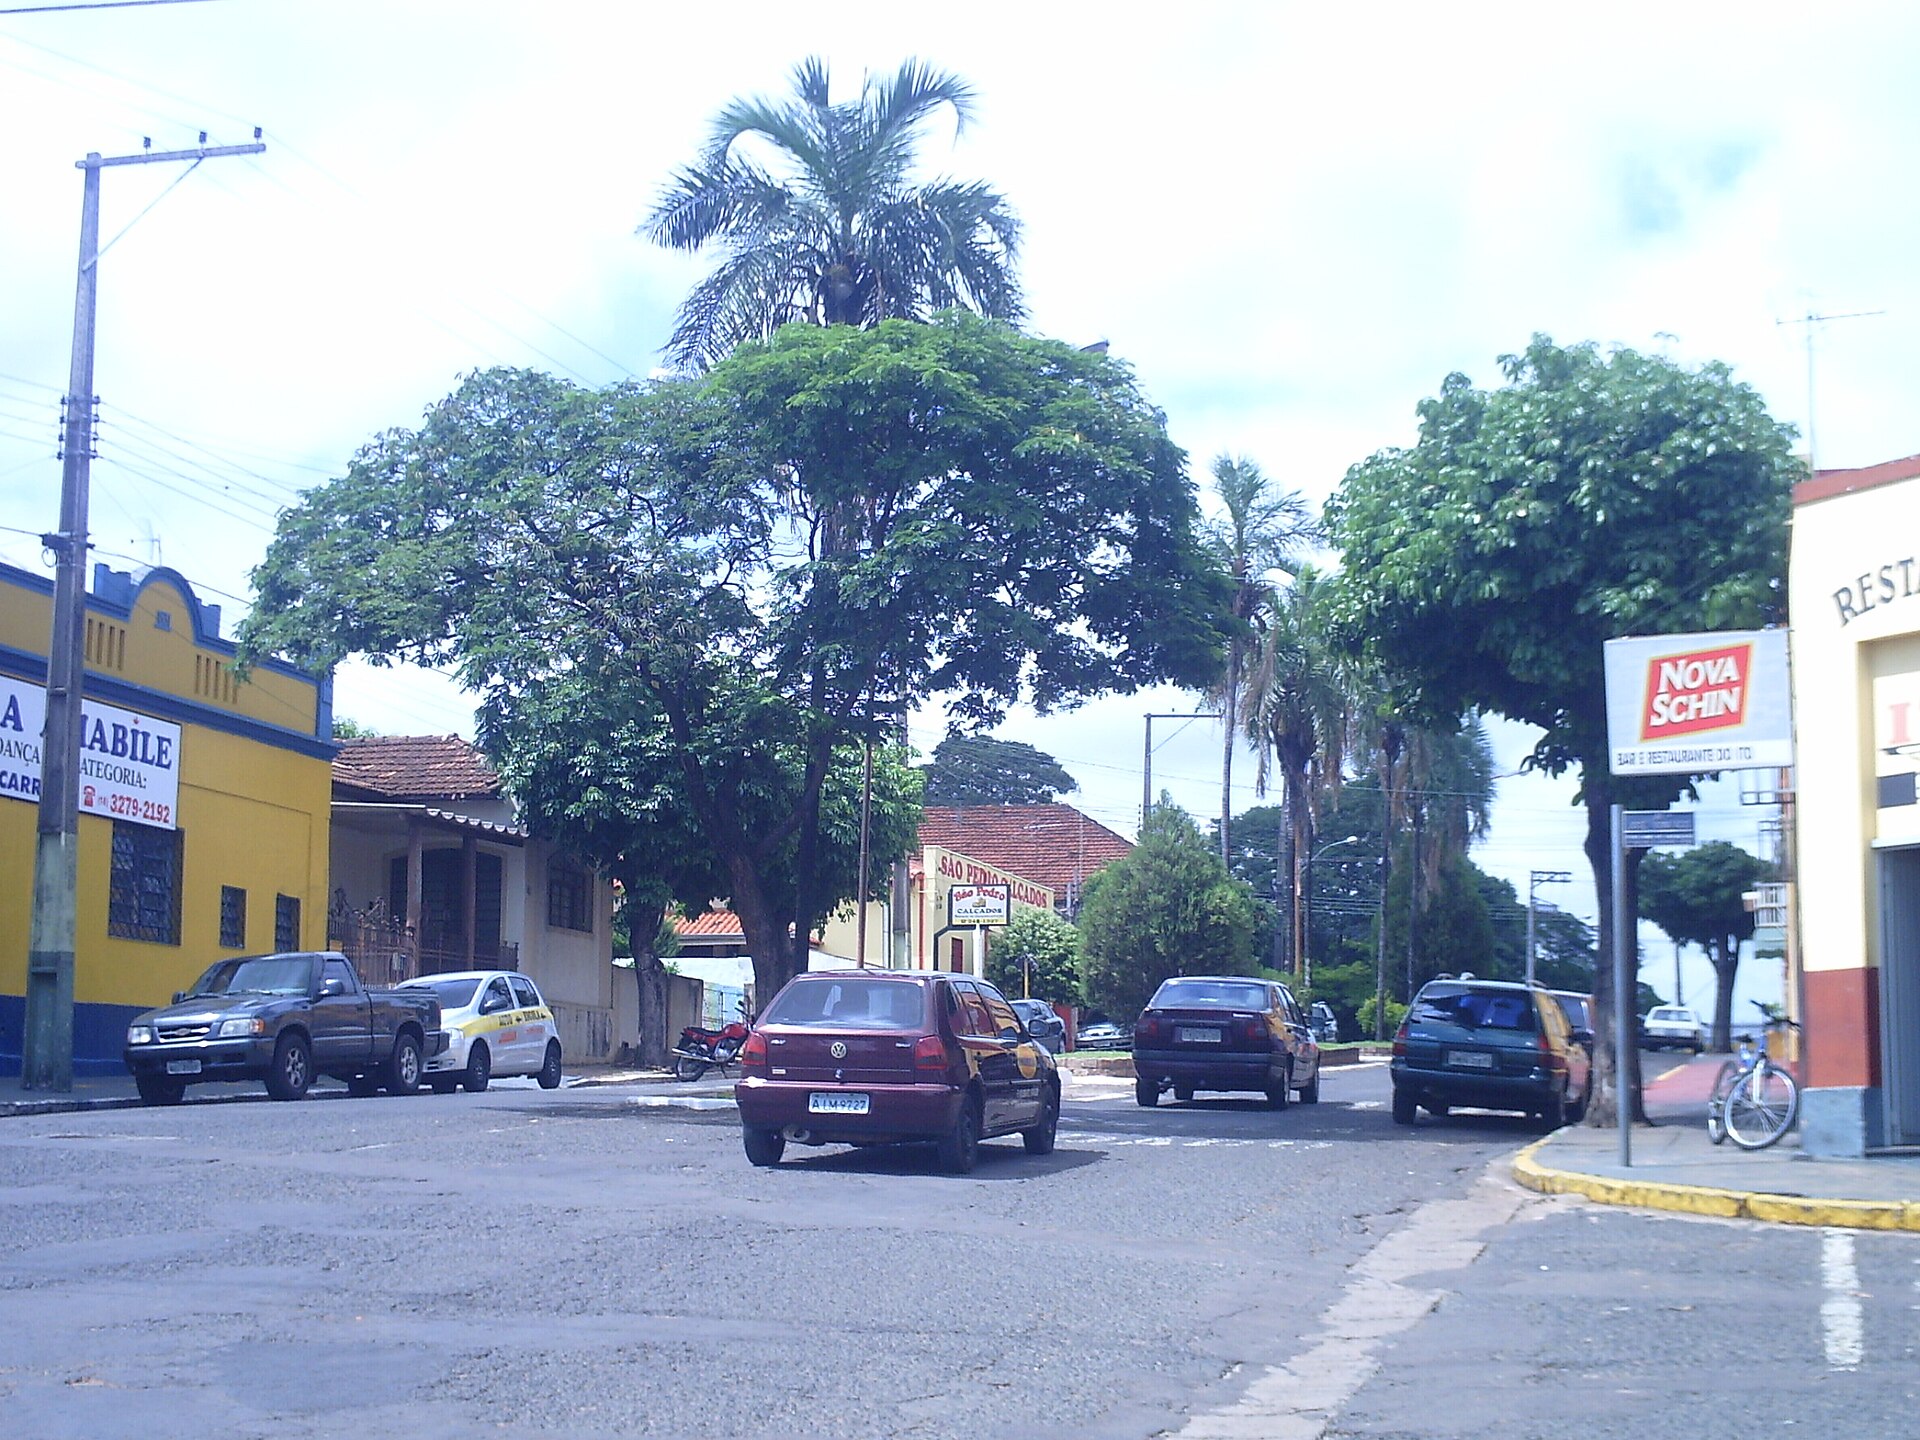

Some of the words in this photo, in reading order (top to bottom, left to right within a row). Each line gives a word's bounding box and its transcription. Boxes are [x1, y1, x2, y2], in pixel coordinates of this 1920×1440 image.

[1831, 556, 1920, 628] REST
[1657, 654, 1741, 694] NOVA
[1649, 686, 1742, 727] SCHIN
[40, 714, 173, 770] ABILE
[1648, 748, 1713, 765] RESTAURANTE
[80, 758, 148, 789] ATEGORIA:
[110, 794, 171, 824] 3279-2192
[976, 886, 1005, 901] Pedro
